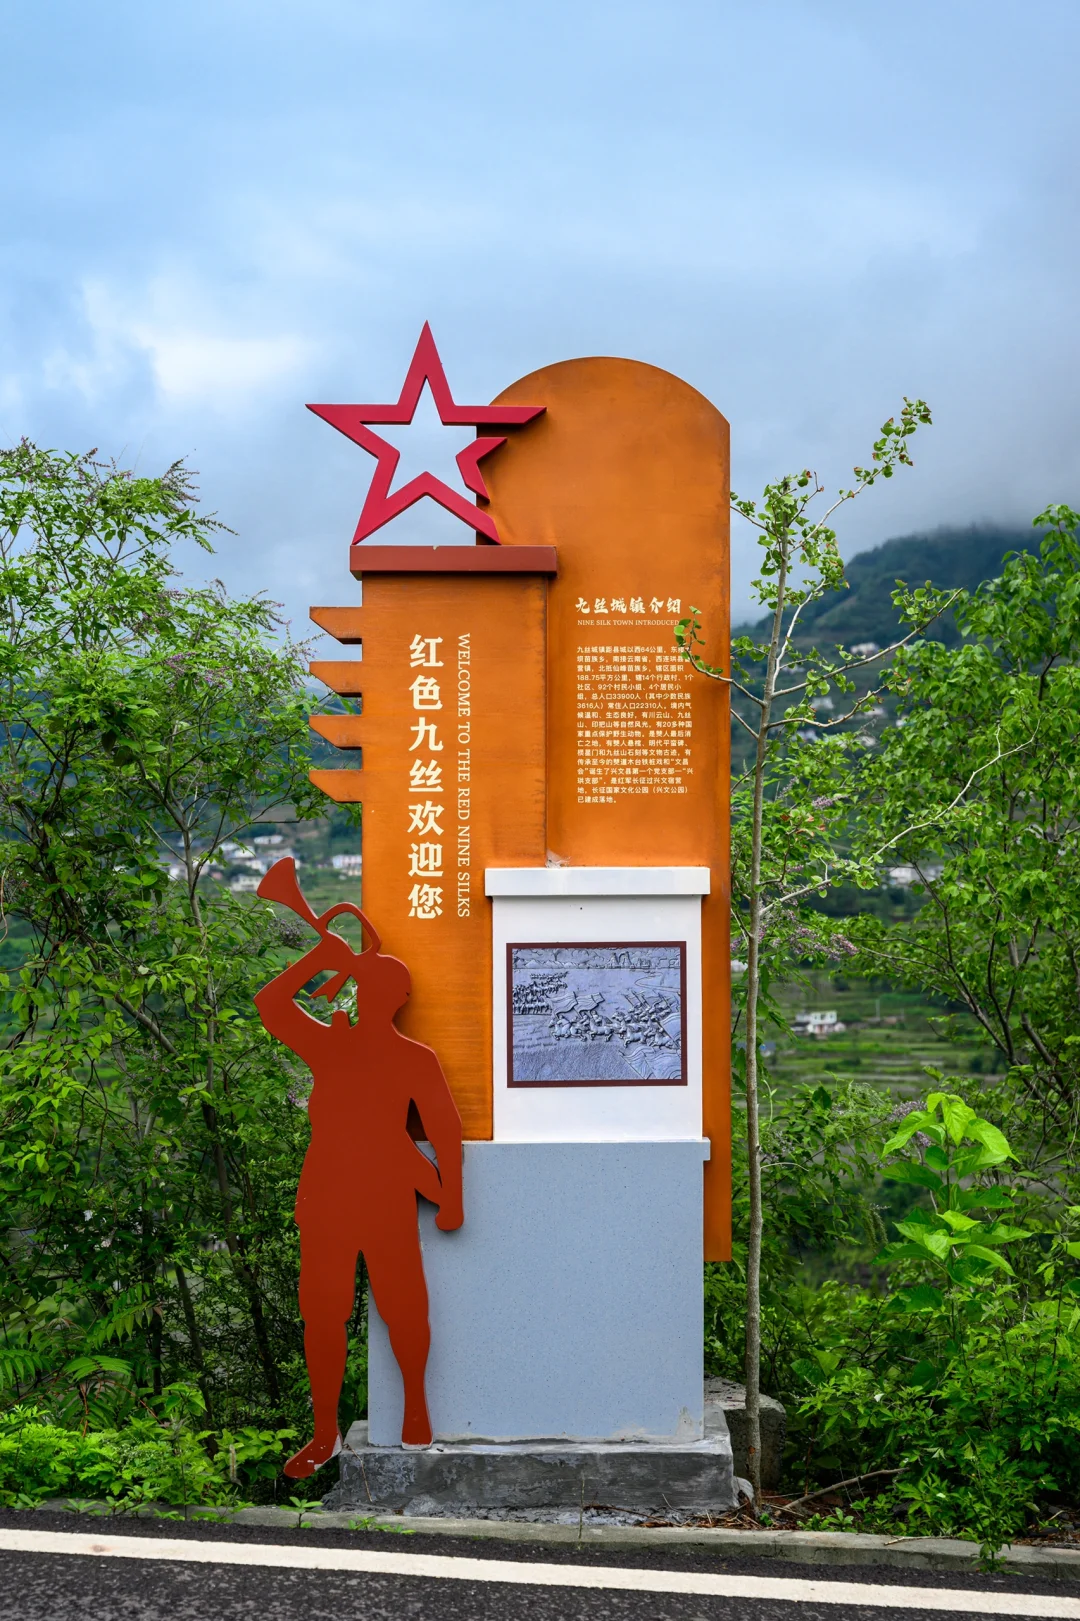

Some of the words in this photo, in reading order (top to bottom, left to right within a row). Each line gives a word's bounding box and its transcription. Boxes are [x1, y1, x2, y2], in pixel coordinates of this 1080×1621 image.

[575, 597, 682, 614] 九丝城镇介绍
[457, 633, 471, 716] WELCOME
[576, 655, 691, 663] 坝苗族乡，南接云南省，西连珙县
[457, 722, 471, 744] TO
[407, 634, 444, 919] 红色九丝欢迎您
[457, 749, 471, 782] THE
[457, 788, 471, 820] RED
[457, 826, 471, 866] NINE
[457, 872, 471, 917] SILKS
